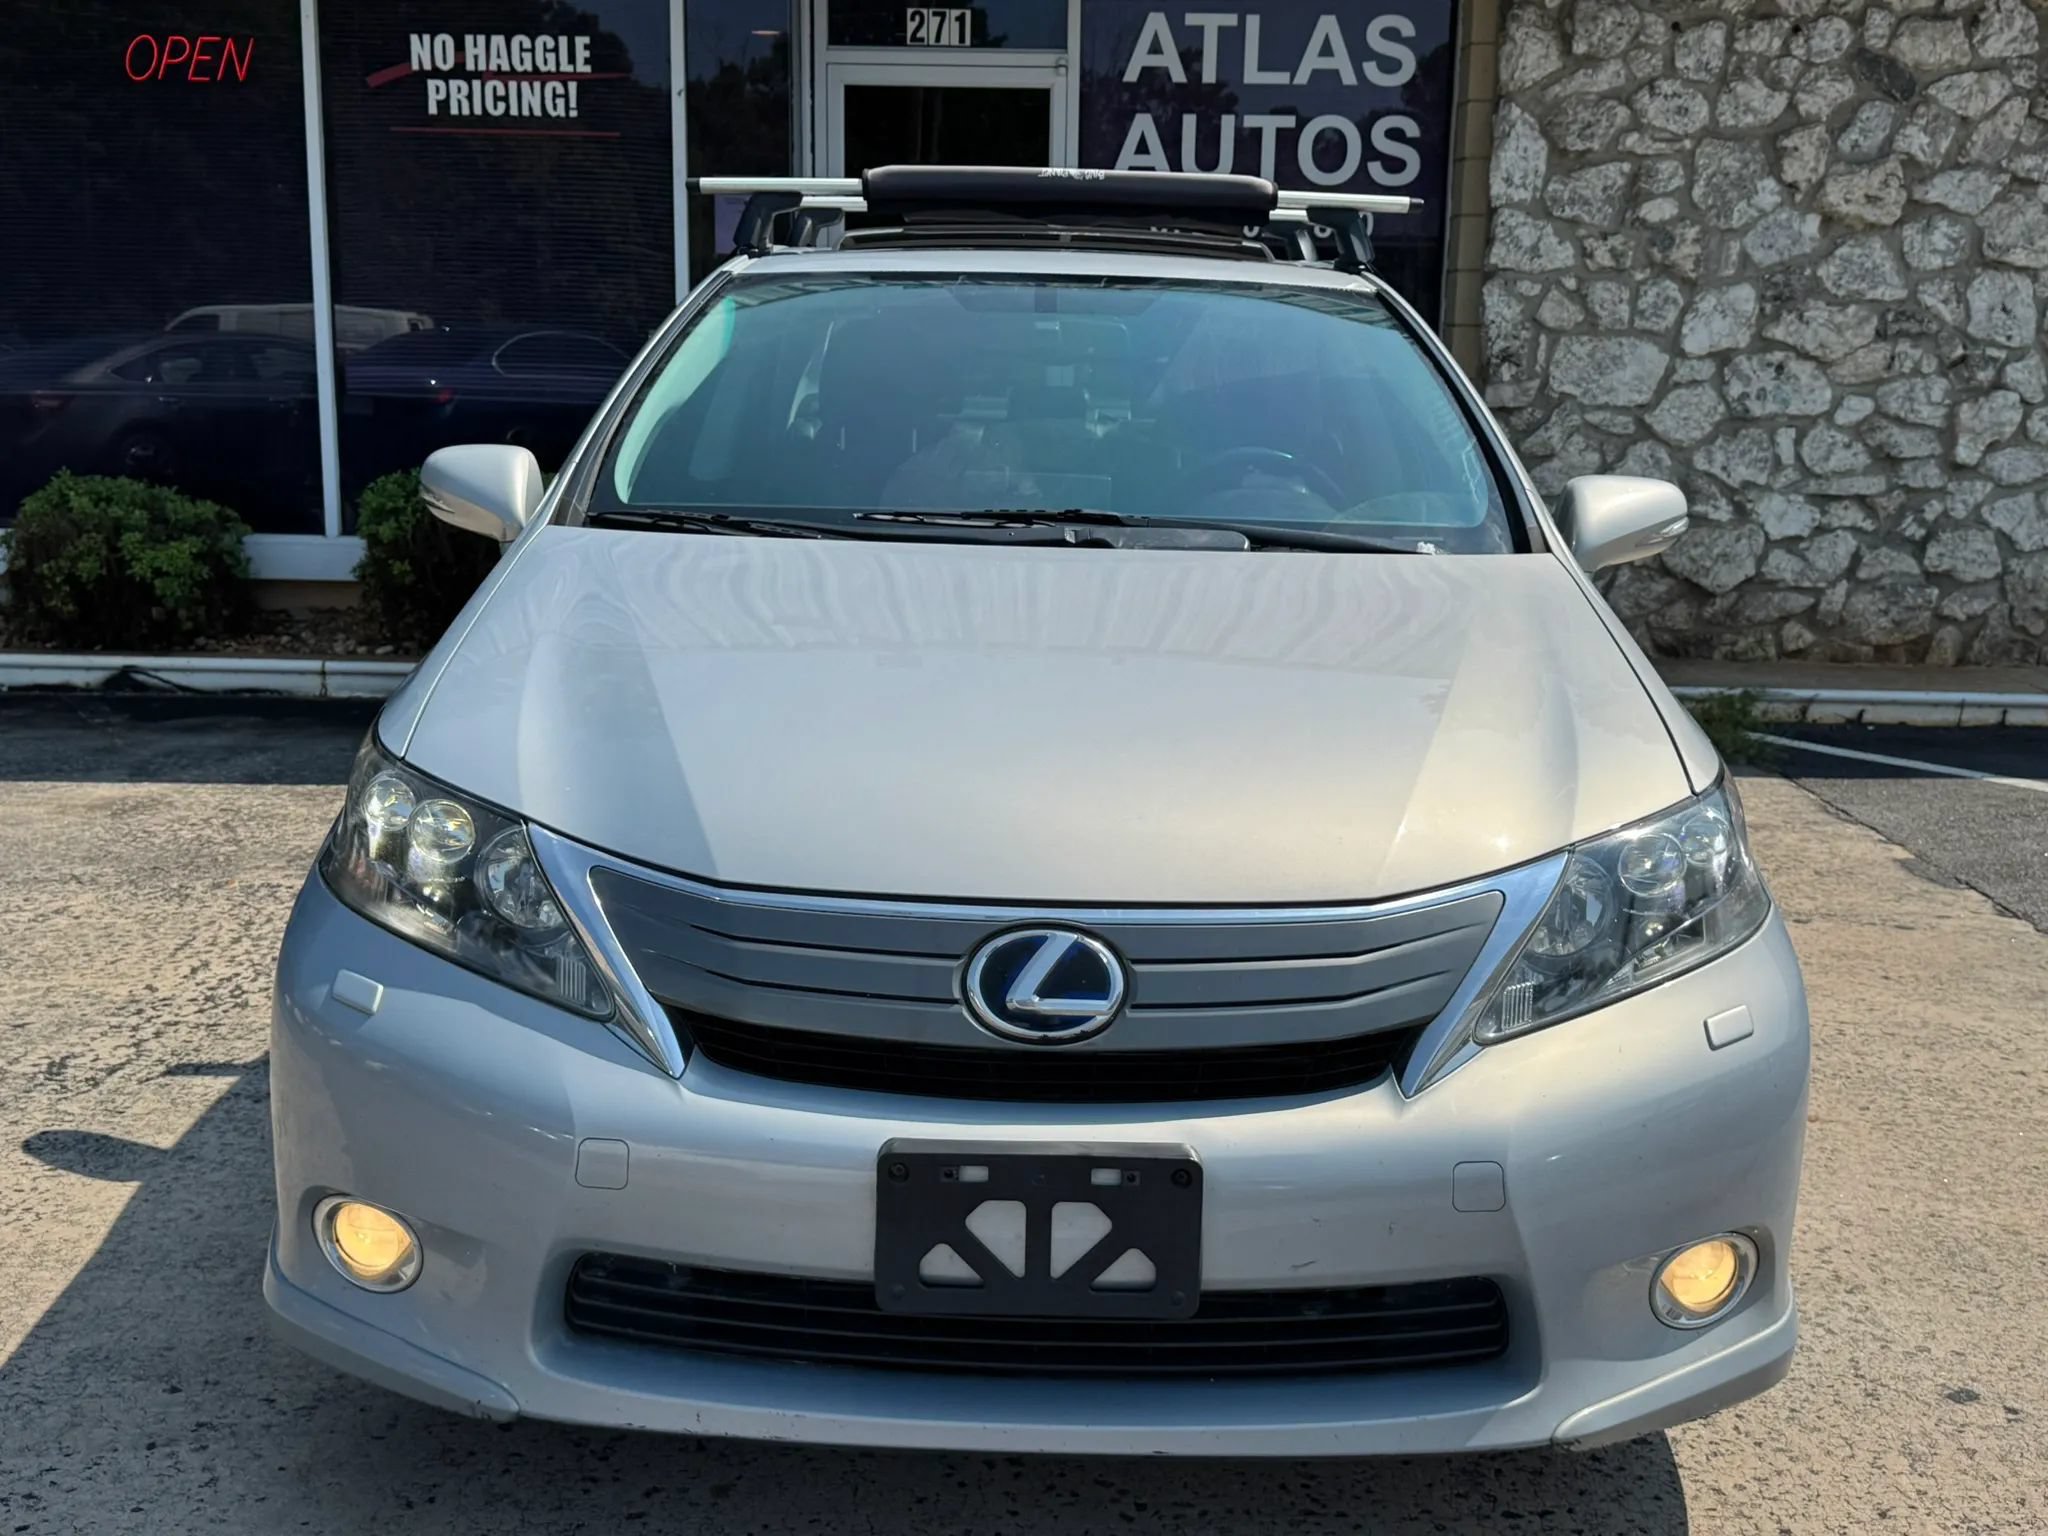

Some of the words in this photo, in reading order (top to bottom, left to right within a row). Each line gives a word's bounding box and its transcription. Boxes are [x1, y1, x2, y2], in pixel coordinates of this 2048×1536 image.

[908, 9, 968, 45] 271
[1122, 11, 1418, 88] ATLAS
[126, 34, 254, 82] OPEN
[409, 32, 456, 72] NO
[463, 33, 593, 74] HAGGLE
[426, 78, 579, 118] PRICING!
[1113, 112, 1422, 188] AUTOS
